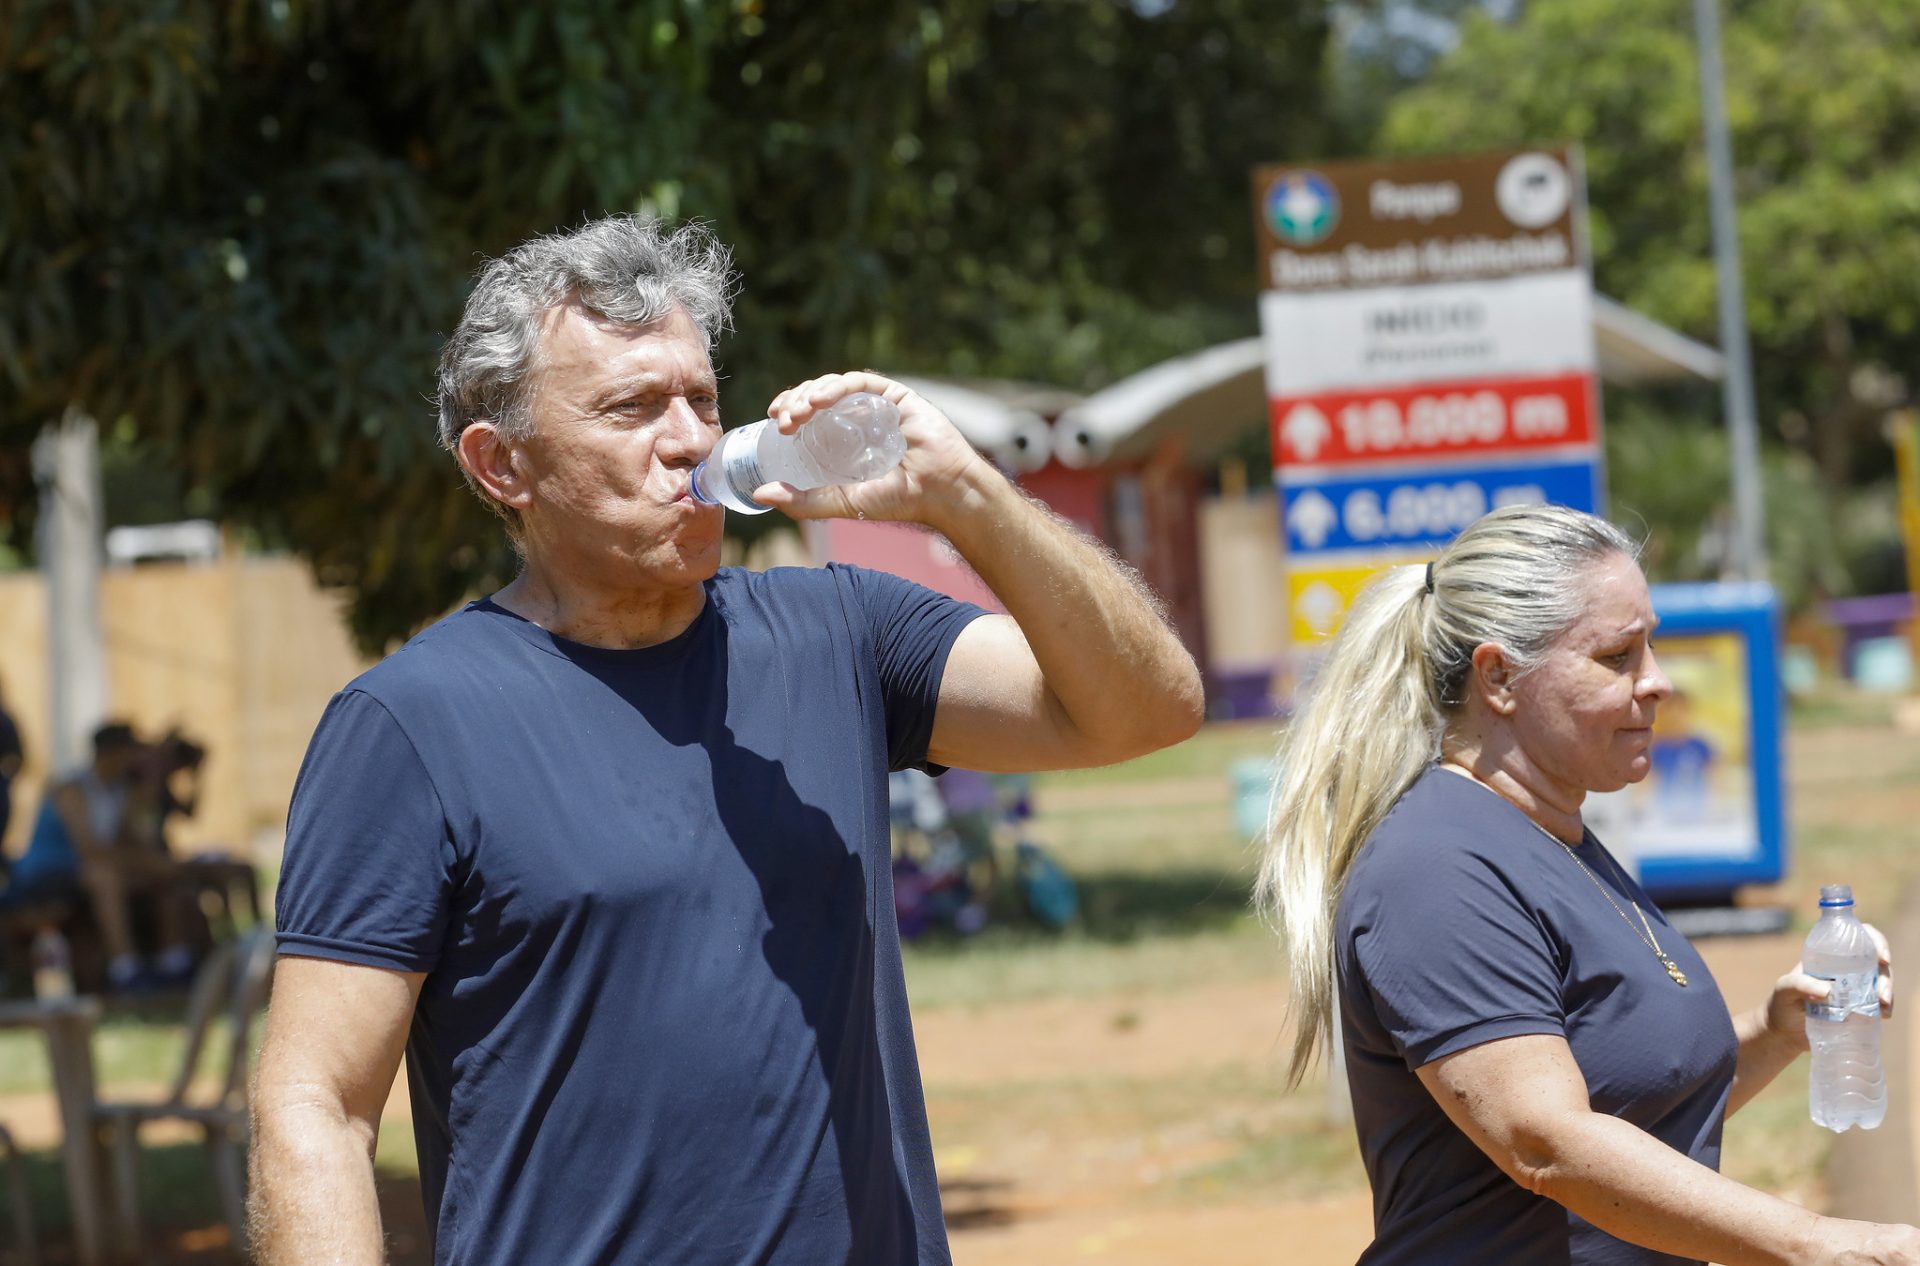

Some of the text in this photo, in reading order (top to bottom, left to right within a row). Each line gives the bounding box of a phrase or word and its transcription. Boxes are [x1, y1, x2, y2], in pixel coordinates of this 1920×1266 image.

[1340, 391, 1568, 451] 10.000 m
[1344, 482, 1487, 540] 6.000
